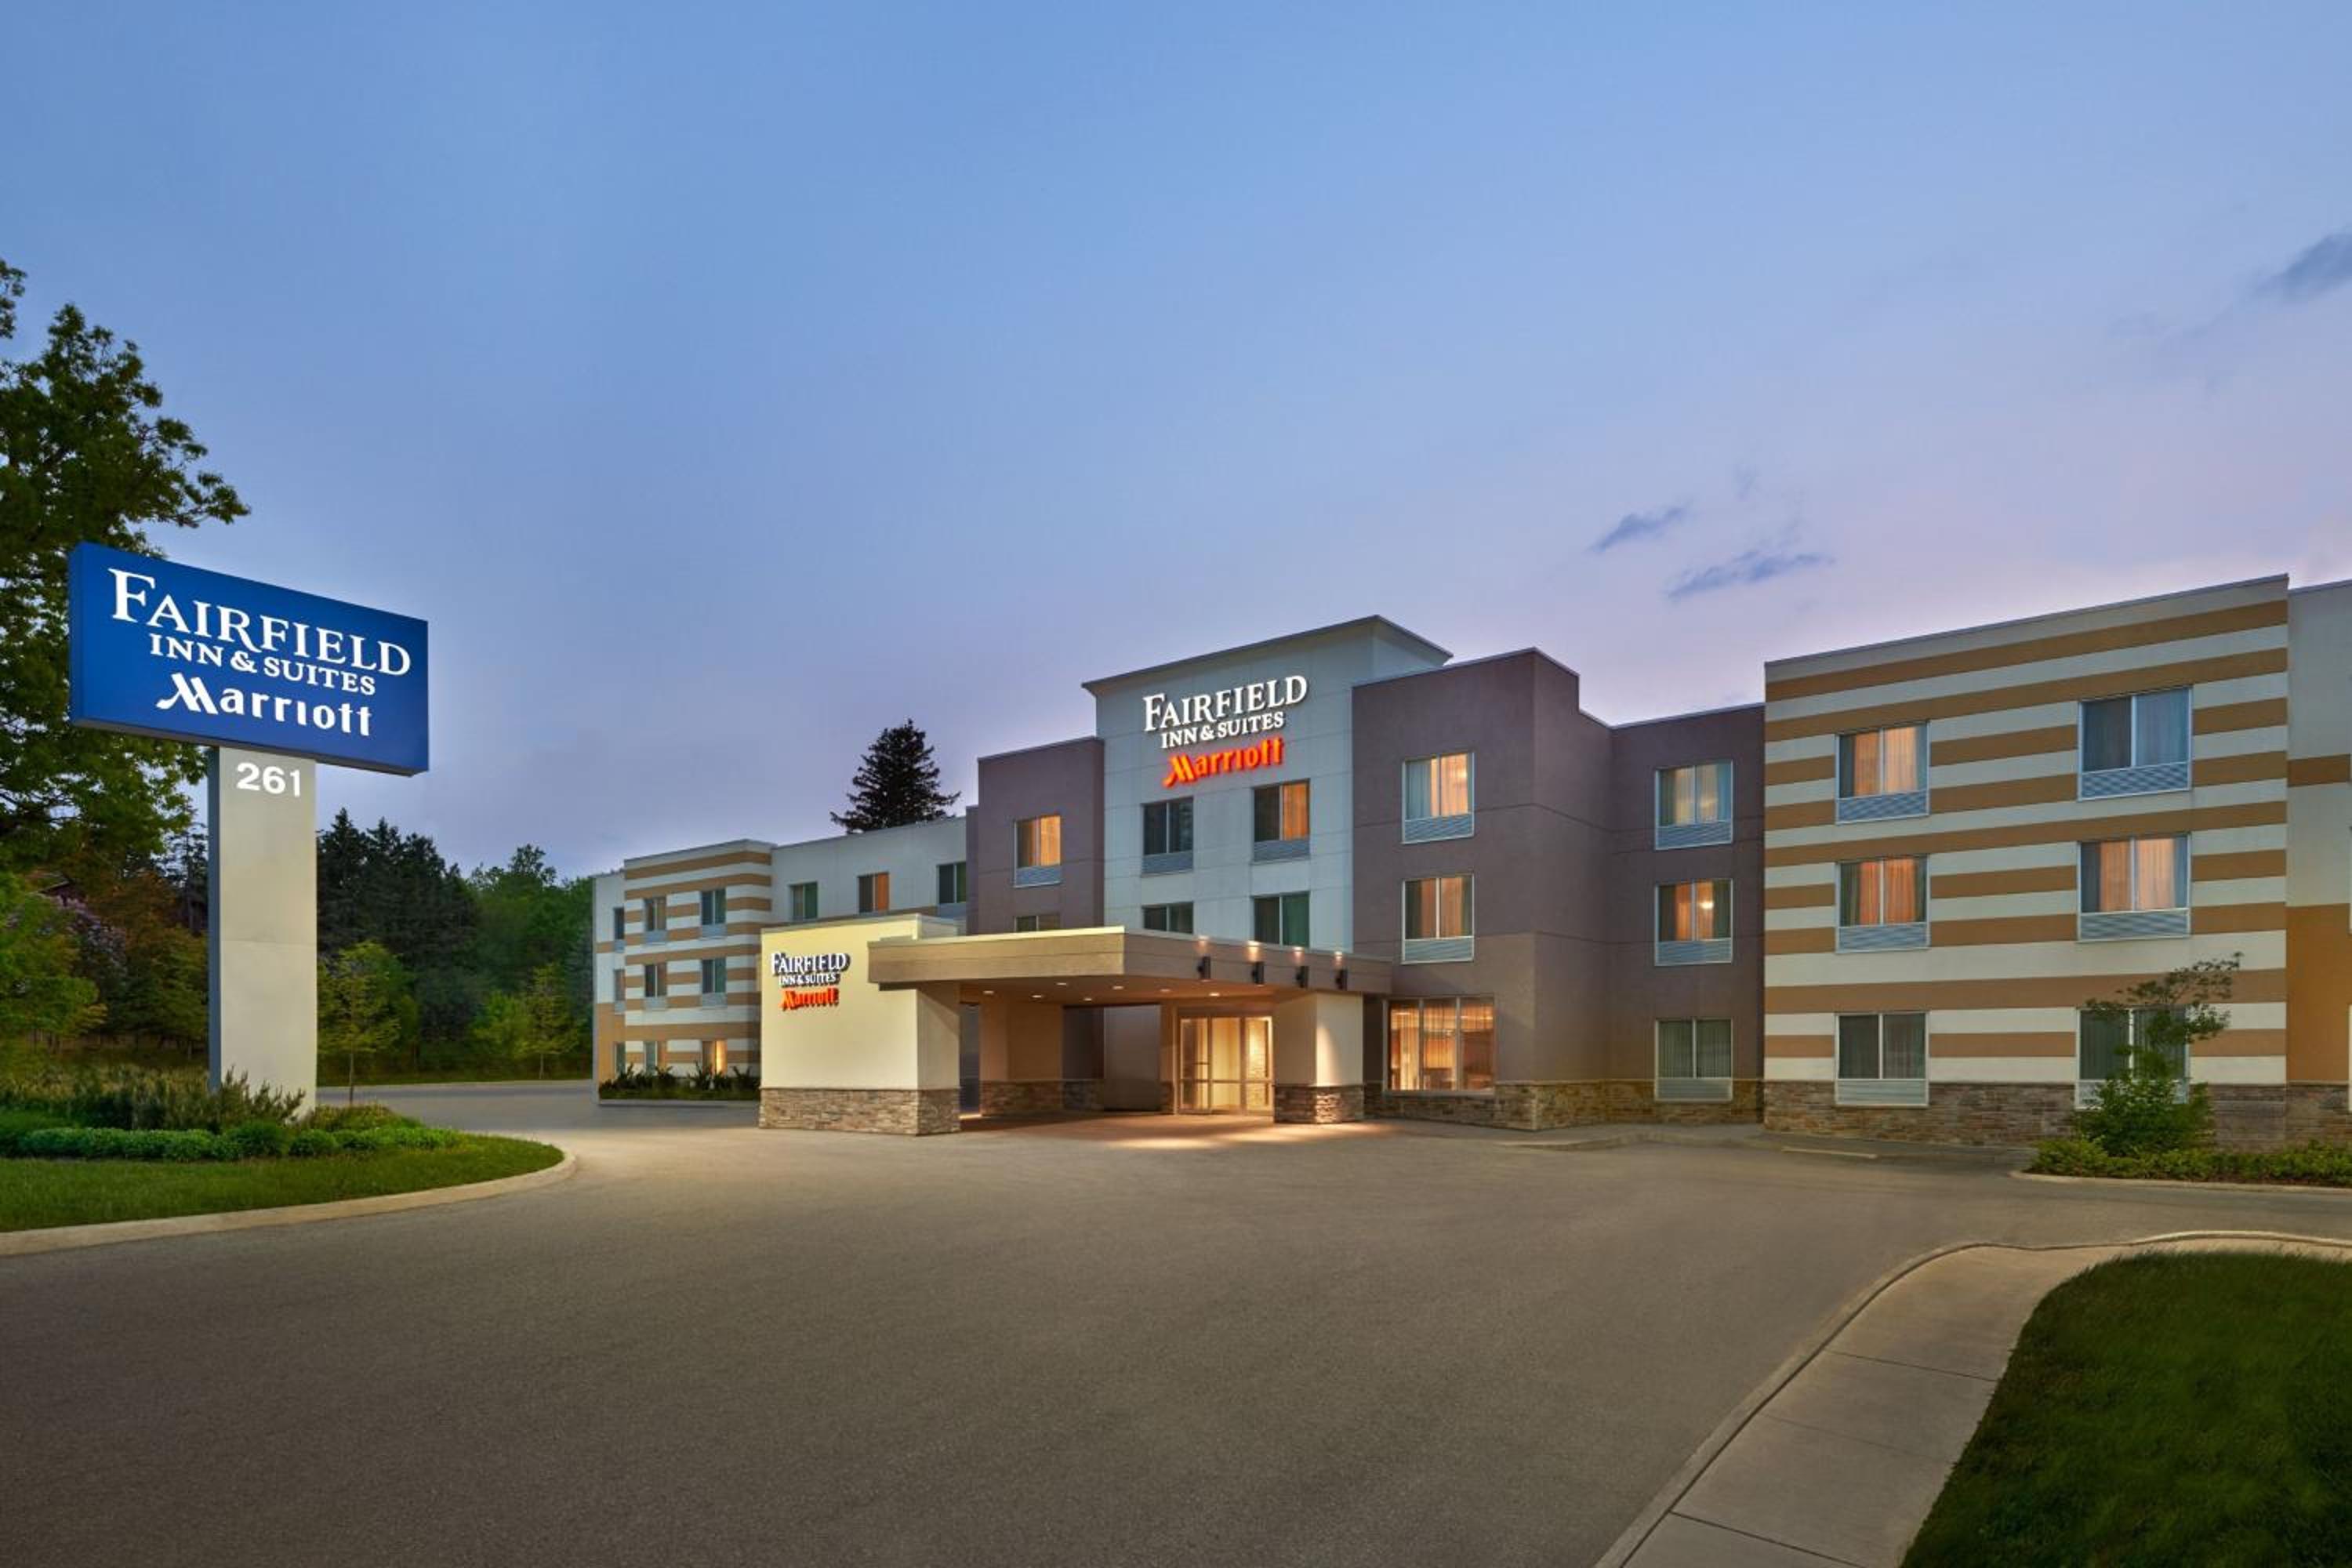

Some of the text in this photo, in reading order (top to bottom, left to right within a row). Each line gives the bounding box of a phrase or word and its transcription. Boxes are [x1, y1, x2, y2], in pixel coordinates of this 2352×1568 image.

[107, 568, 411, 677] FAIRFIELD
[149, 632, 376, 696] INN & SUITES
[156, 672, 372, 737] Marriott
[1142, 675, 1308, 732] FAIRFIELD
[1161, 711, 1285, 749] INN & SUITES
[236, 762, 302, 797] 261
[1162, 736, 1285, 787] Marriott
[771, 952, 848, 975] FAIRFIELD
[779, 975, 796, 986] INN
[804, 972, 837, 984] SUITES
